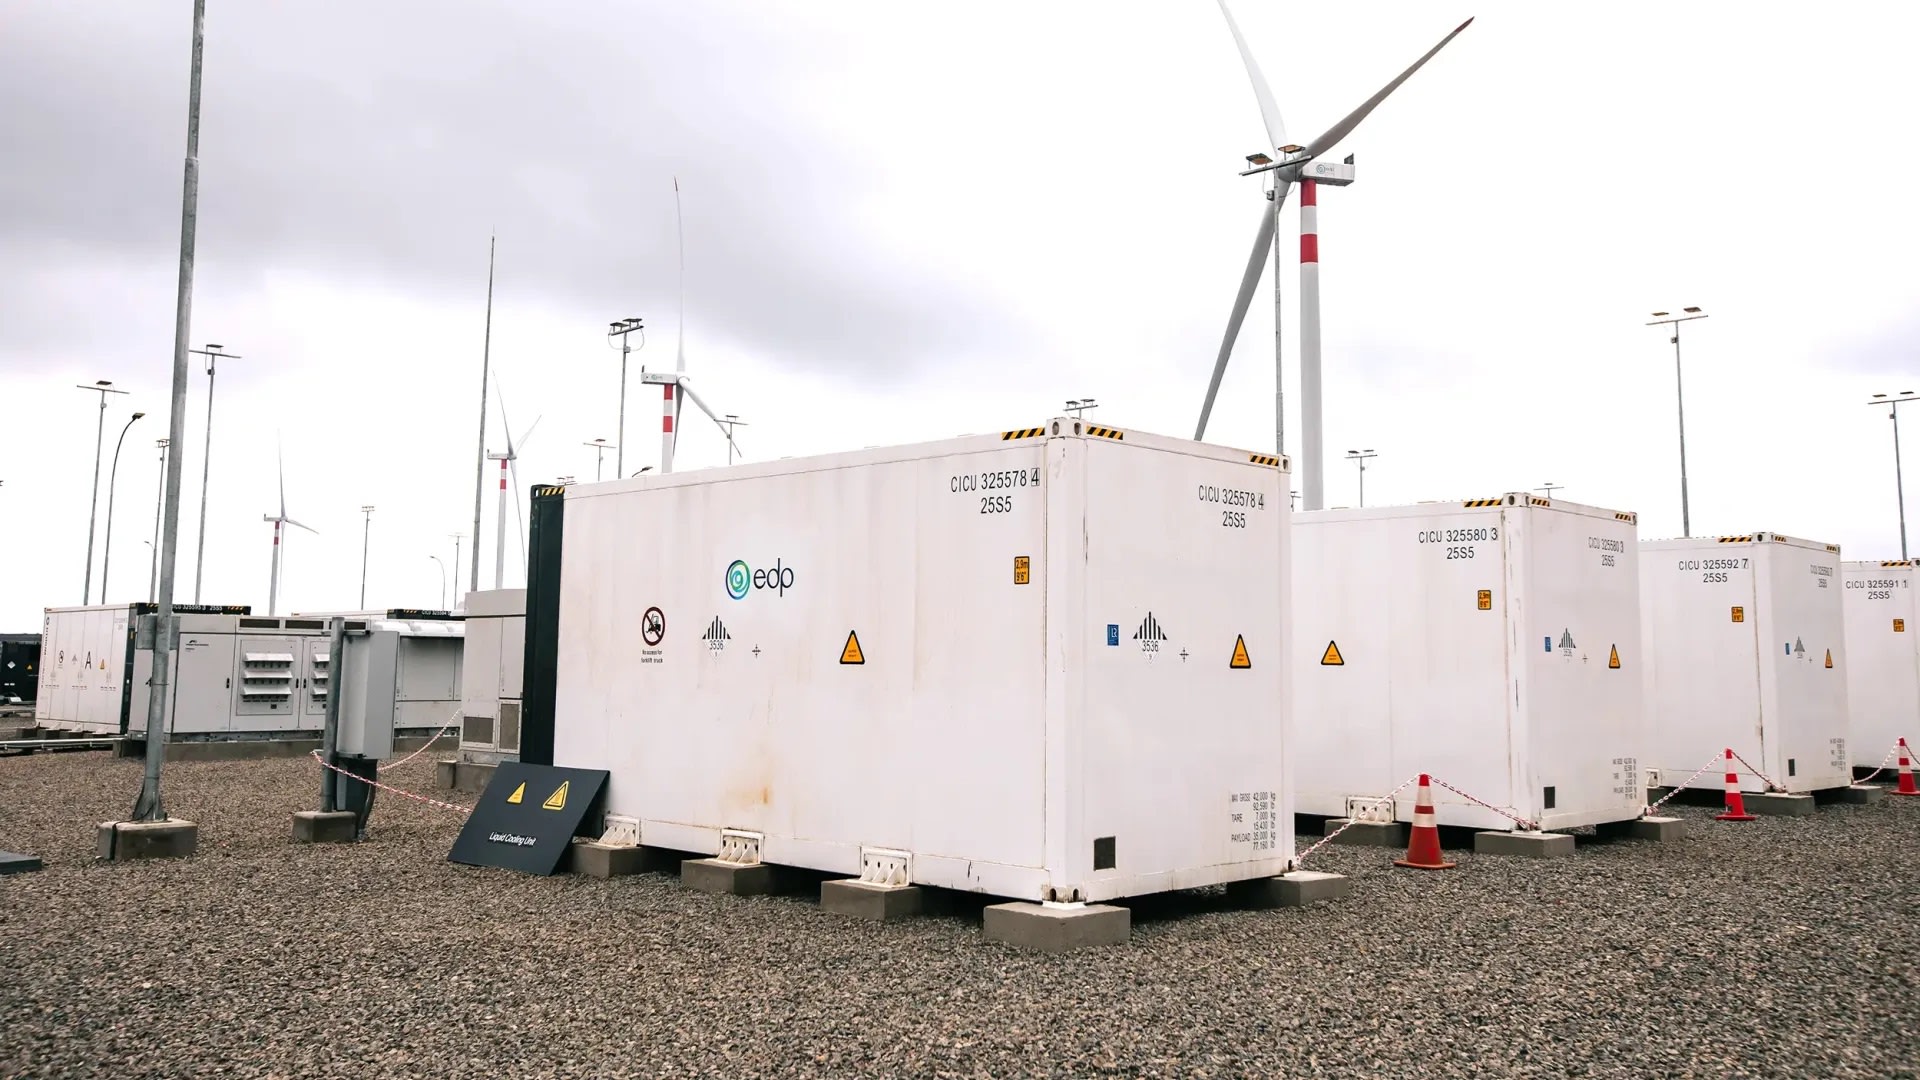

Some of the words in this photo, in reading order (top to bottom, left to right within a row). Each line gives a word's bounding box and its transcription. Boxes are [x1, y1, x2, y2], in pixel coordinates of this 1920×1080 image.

[951, 475, 977, 492] CICU
[981, 470, 1027, 489] 325578
[1031, 468, 1039, 486] 4
[1199, 485, 1219, 502] CICU
[1222, 489, 1256, 508] 325578
[1258, 494, 1264, 510] 4
[981, 496, 1012, 514] 25S5
[1223, 511, 1245, 528] 25S5
[1418, 531, 1442, 543] CICU
[1446, 528, 1487, 542] 325580
[1491, 528, 1498, 540] 3
[1446, 547, 1475, 560] 25S5
[1679, 560, 1699, 570] CICU
[1703, 559, 1738, 570] 325592
[1742, 559, 1748, 569] 7
[754, 558, 794, 597] edp
[1703, 573, 1728, 583] 25S5
[1867, 580, 1898, 588] 325591
[1868, 591, 1890, 599] 25S5
[710, 640, 723, 650] 3536
[1142, 640, 1159, 652] 3536
[85, 651, 92, 670] A
[489, 832, 505, 842] Liquid
[505, 834, 524, 845] Cooling
[524, 837, 536, 846] Unit
